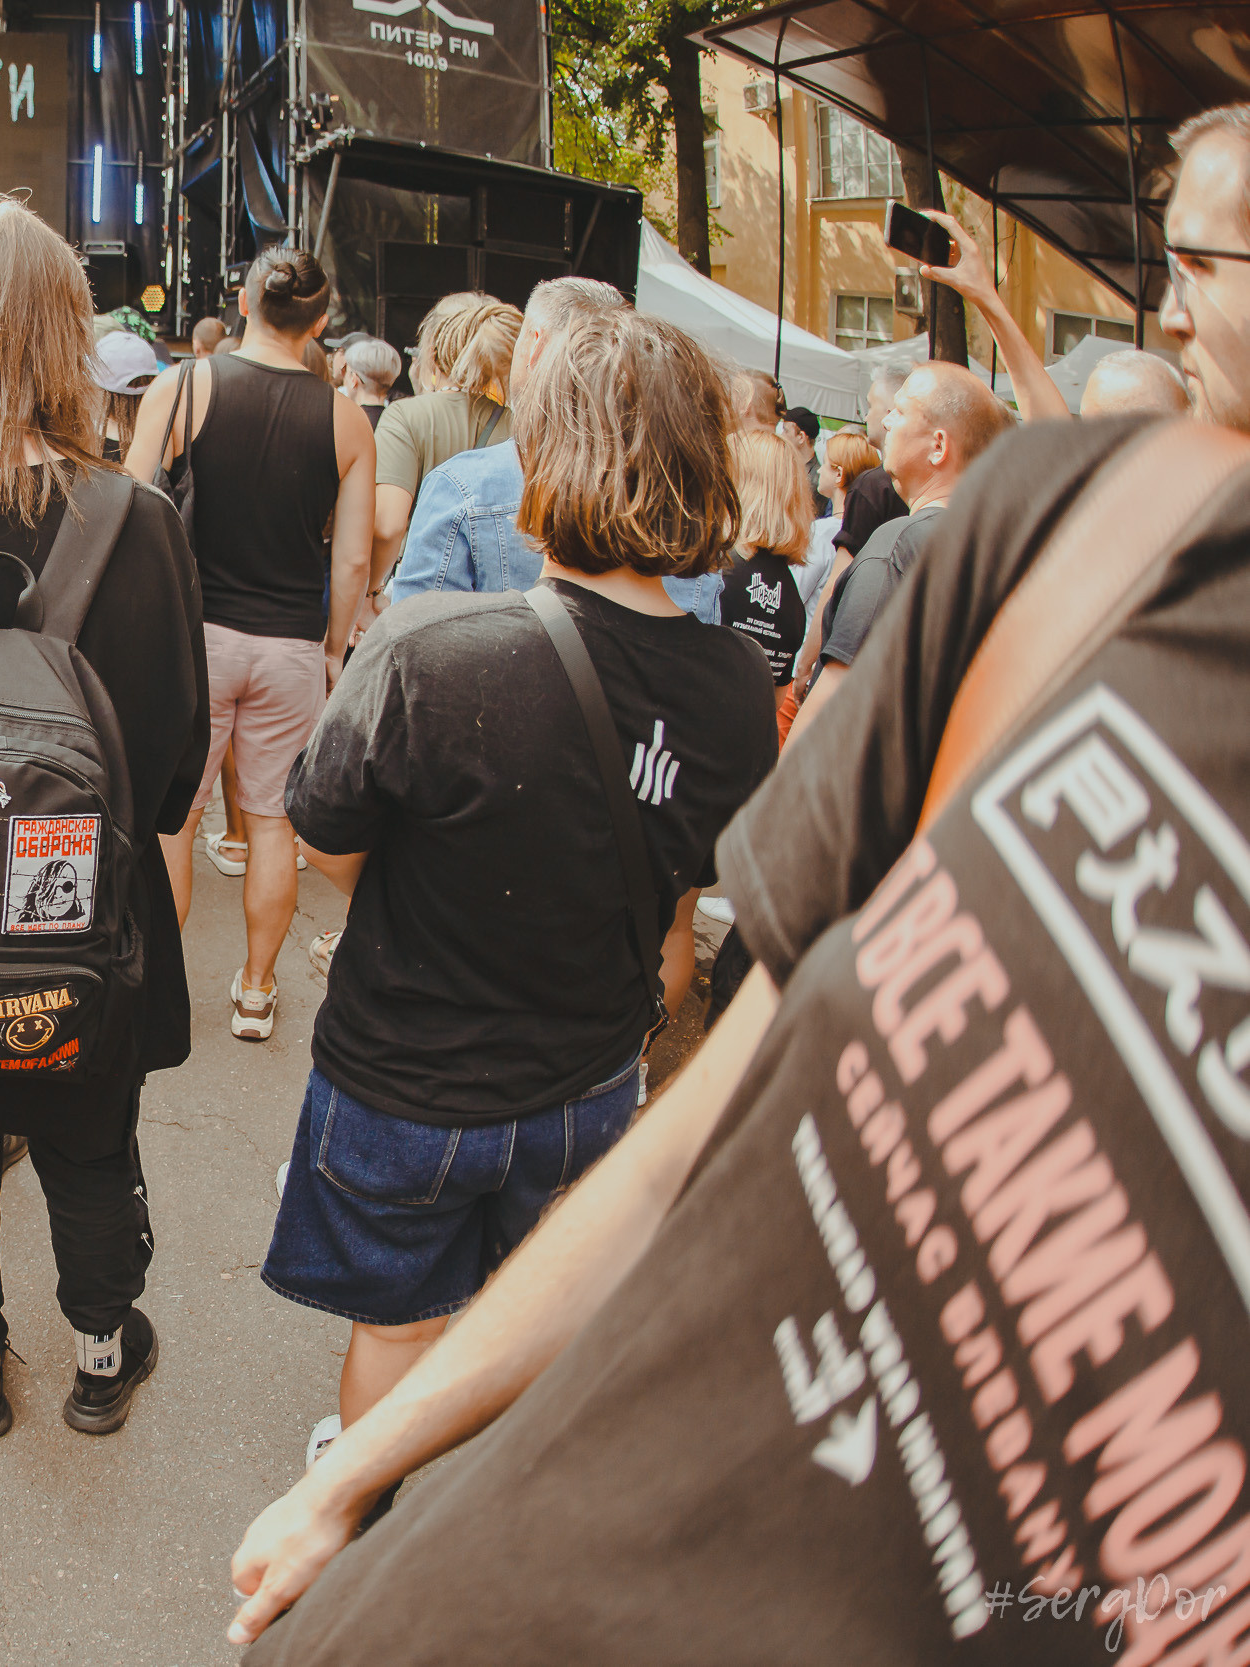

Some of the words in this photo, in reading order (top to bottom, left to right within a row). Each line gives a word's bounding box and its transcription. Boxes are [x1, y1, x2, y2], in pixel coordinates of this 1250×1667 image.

[370, 21, 443, 50] ПИТЕР
[449, 36, 480, 59] FM
[405, 51, 449, 72] 100.9
[16, 819, 95, 837] ГРАЖДАНСКАЯ
[16, 834, 93, 858] ОБОРОНА
[49, 923, 59, 931] ПО
[62, 922, 86, 930] ПЛАНУ
[21, 1058, 39, 1069] OF
[48, 1038, 80, 1066] DOWN
[837, 1041, 958, 1285] СЕЙЧАС
[927, 1004, 1176, 1404] ТАКИЕ
